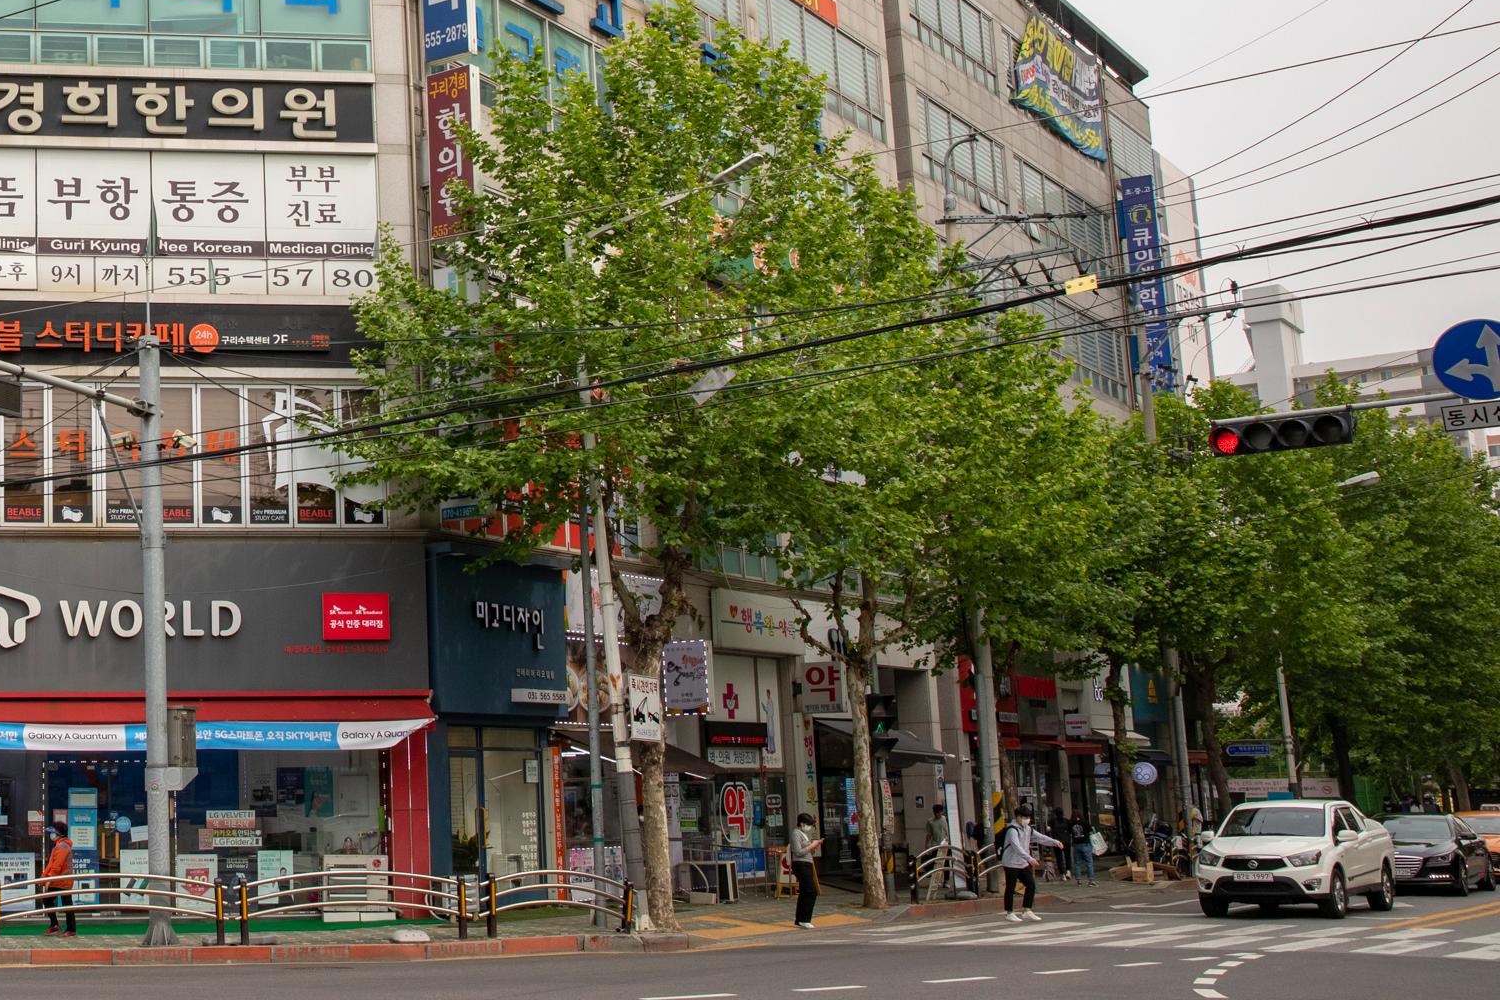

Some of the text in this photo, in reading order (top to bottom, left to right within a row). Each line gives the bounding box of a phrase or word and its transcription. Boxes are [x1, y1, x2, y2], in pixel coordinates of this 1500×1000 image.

[425, 22, 468, 49] 555-2879
[429, 71, 469, 100] 구리경희
[285, 164, 341, 193] 부부
[46, 176, 139, 222] 부항
[161, 179, 249, 224] 통증
[285, 200, 342, 227] 진료
[51, 239, 373, 256] Guri Kyung Hee Korean Medical Clinic
[51, 264, 139, 286] 9시 까지
[194, 329, 214, 341] 24h
[221, 334, 270, 346] 구리수택센터
[7, 508, 42, 516] BEABLE
[300, 509, 332, 518] BEABLE
[59, 600, 242, 639] WORLD
[330, 620, 383, 628] 공식 인증 대리점
[476, 601, 545, 649] 미고디자인
[805, 665, 840, 702] 약
[28, 731, 62, 742] Galaxy
[72, 731, 117, 740] Quantum
[266, 730, 375, 741] 오직 SKT에서만 Galaxy
[209, 811, 247, 820] LG VELVET
[723, 788, 745, 838] 약
